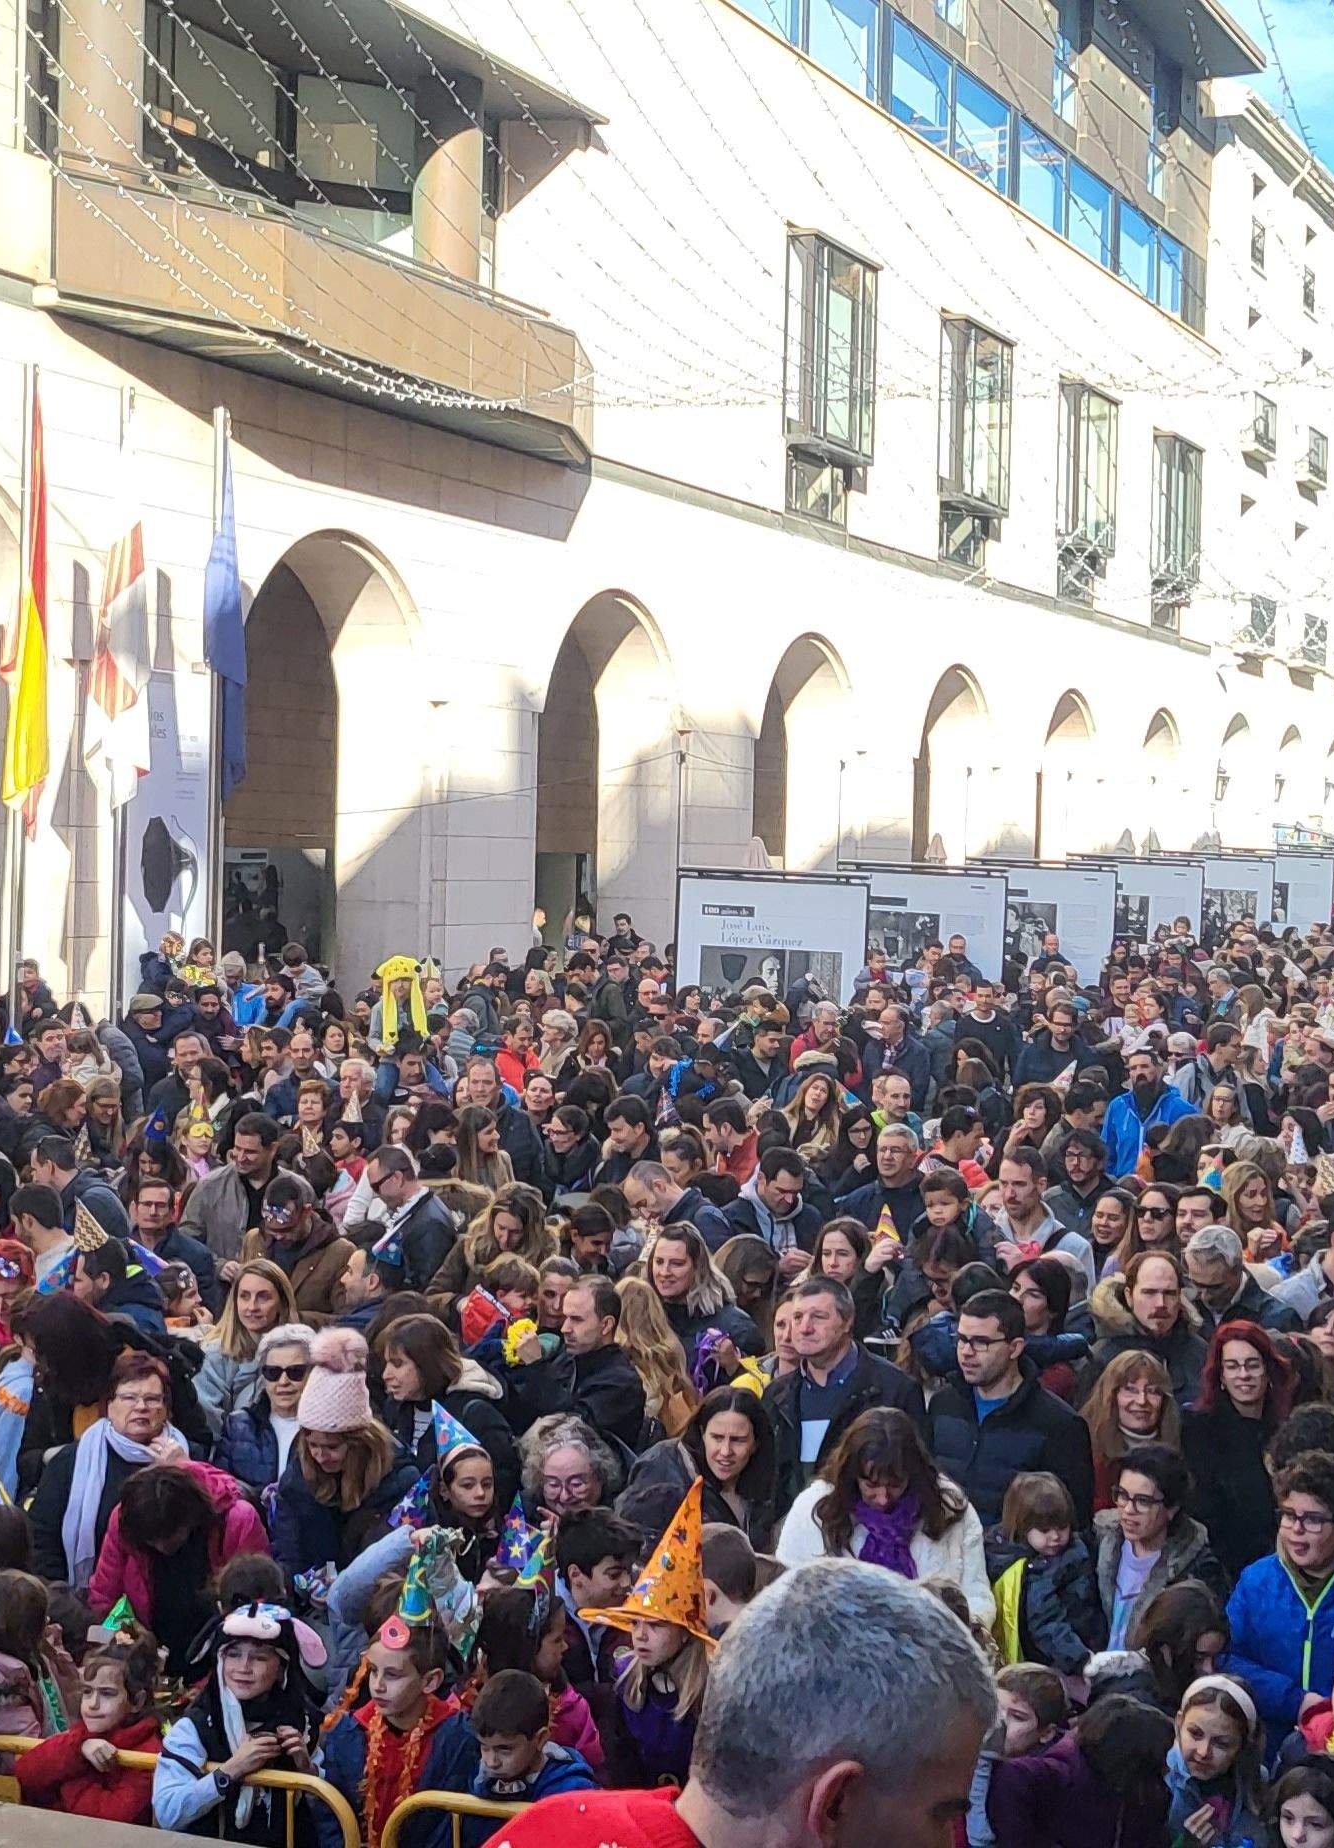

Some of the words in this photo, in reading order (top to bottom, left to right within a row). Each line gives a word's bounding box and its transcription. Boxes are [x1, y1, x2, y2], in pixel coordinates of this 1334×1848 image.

[721, 919, 743, 930] José
[747, 920, 770, 931] Luis
[721, 932, 753, 946] López
[757, 934, 803, 948] Vázquez
